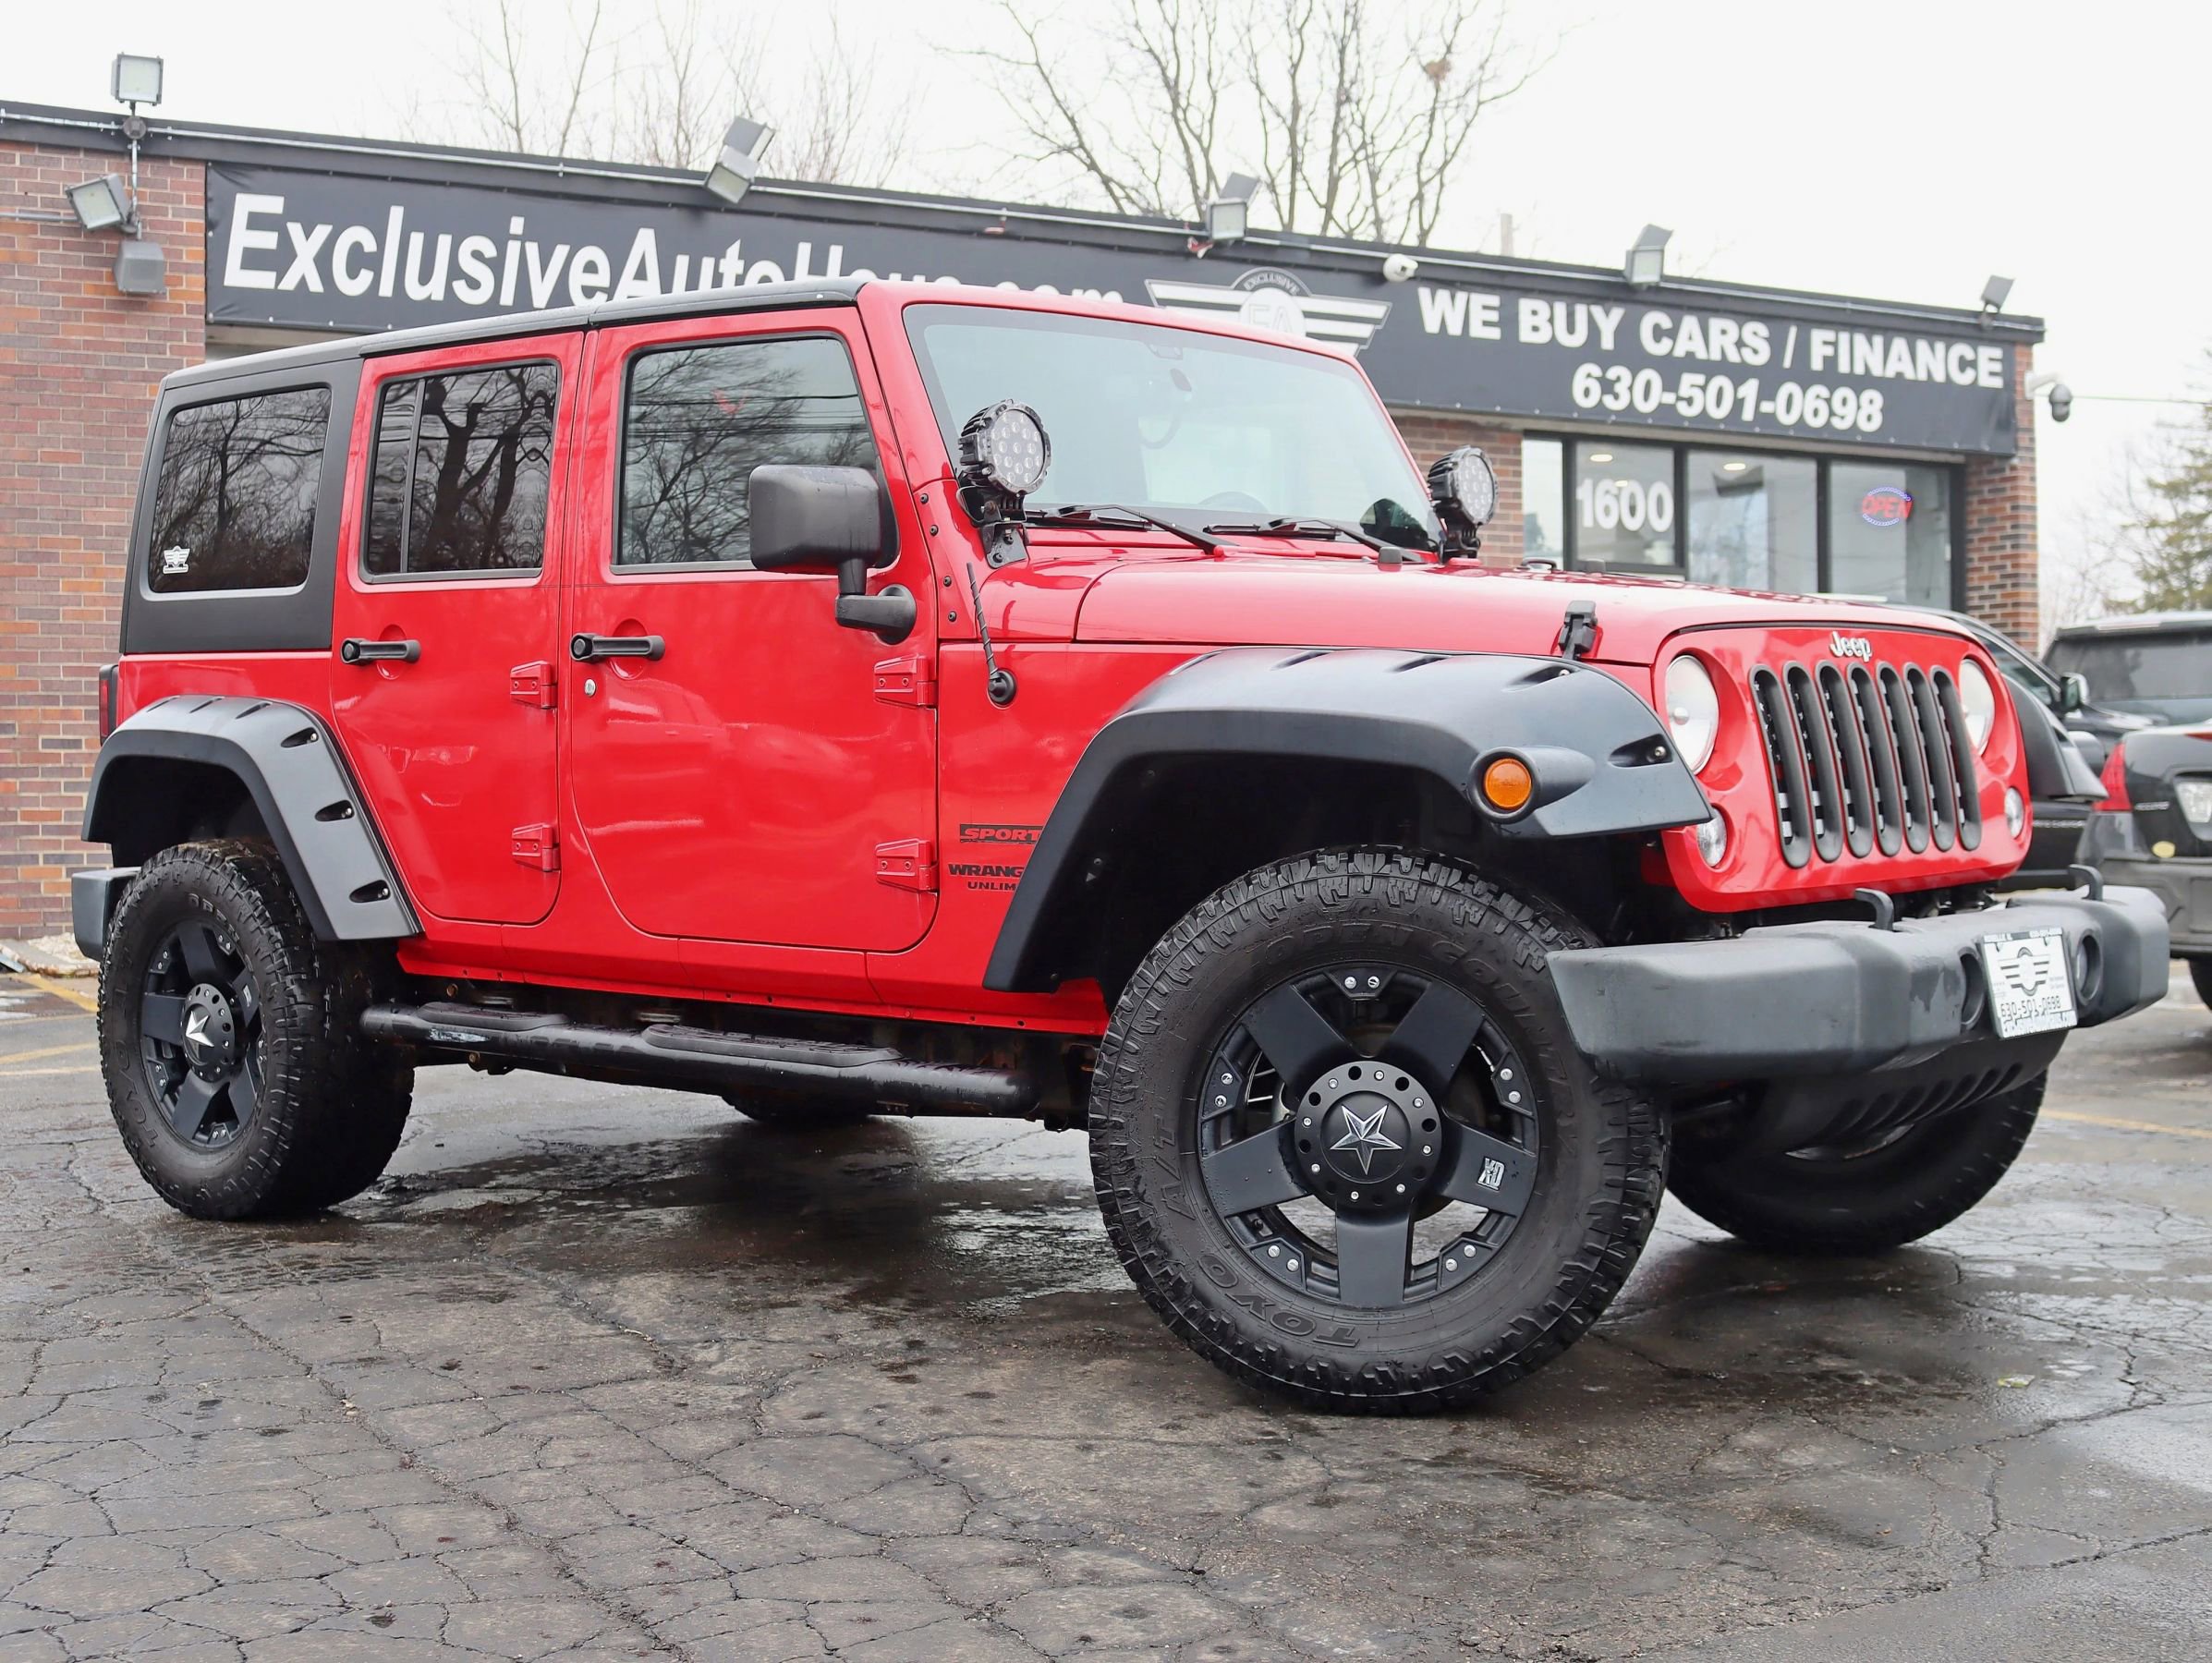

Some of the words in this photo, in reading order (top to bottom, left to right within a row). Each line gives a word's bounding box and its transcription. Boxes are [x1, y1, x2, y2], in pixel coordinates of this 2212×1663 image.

[1417, 287, 1501, 340] WE
[1518, 297, 1625, 350] BUY
[1639, 310, 1771, 366] CARS
[1783, 325, 1797, 369] /
[1810, 329, 2004, 389] FINANCE
[1572, 362, 1884, 432] 630-501-0698
[1575, 478, 1674, 533] 1600
[1862, 494, 1914, 520] OPEN
[1829, 630, 1873, 662] Jeep
[964, 828, 1042, 842] SPORT
[1198, 1254, 1361, 1348] TOYO
